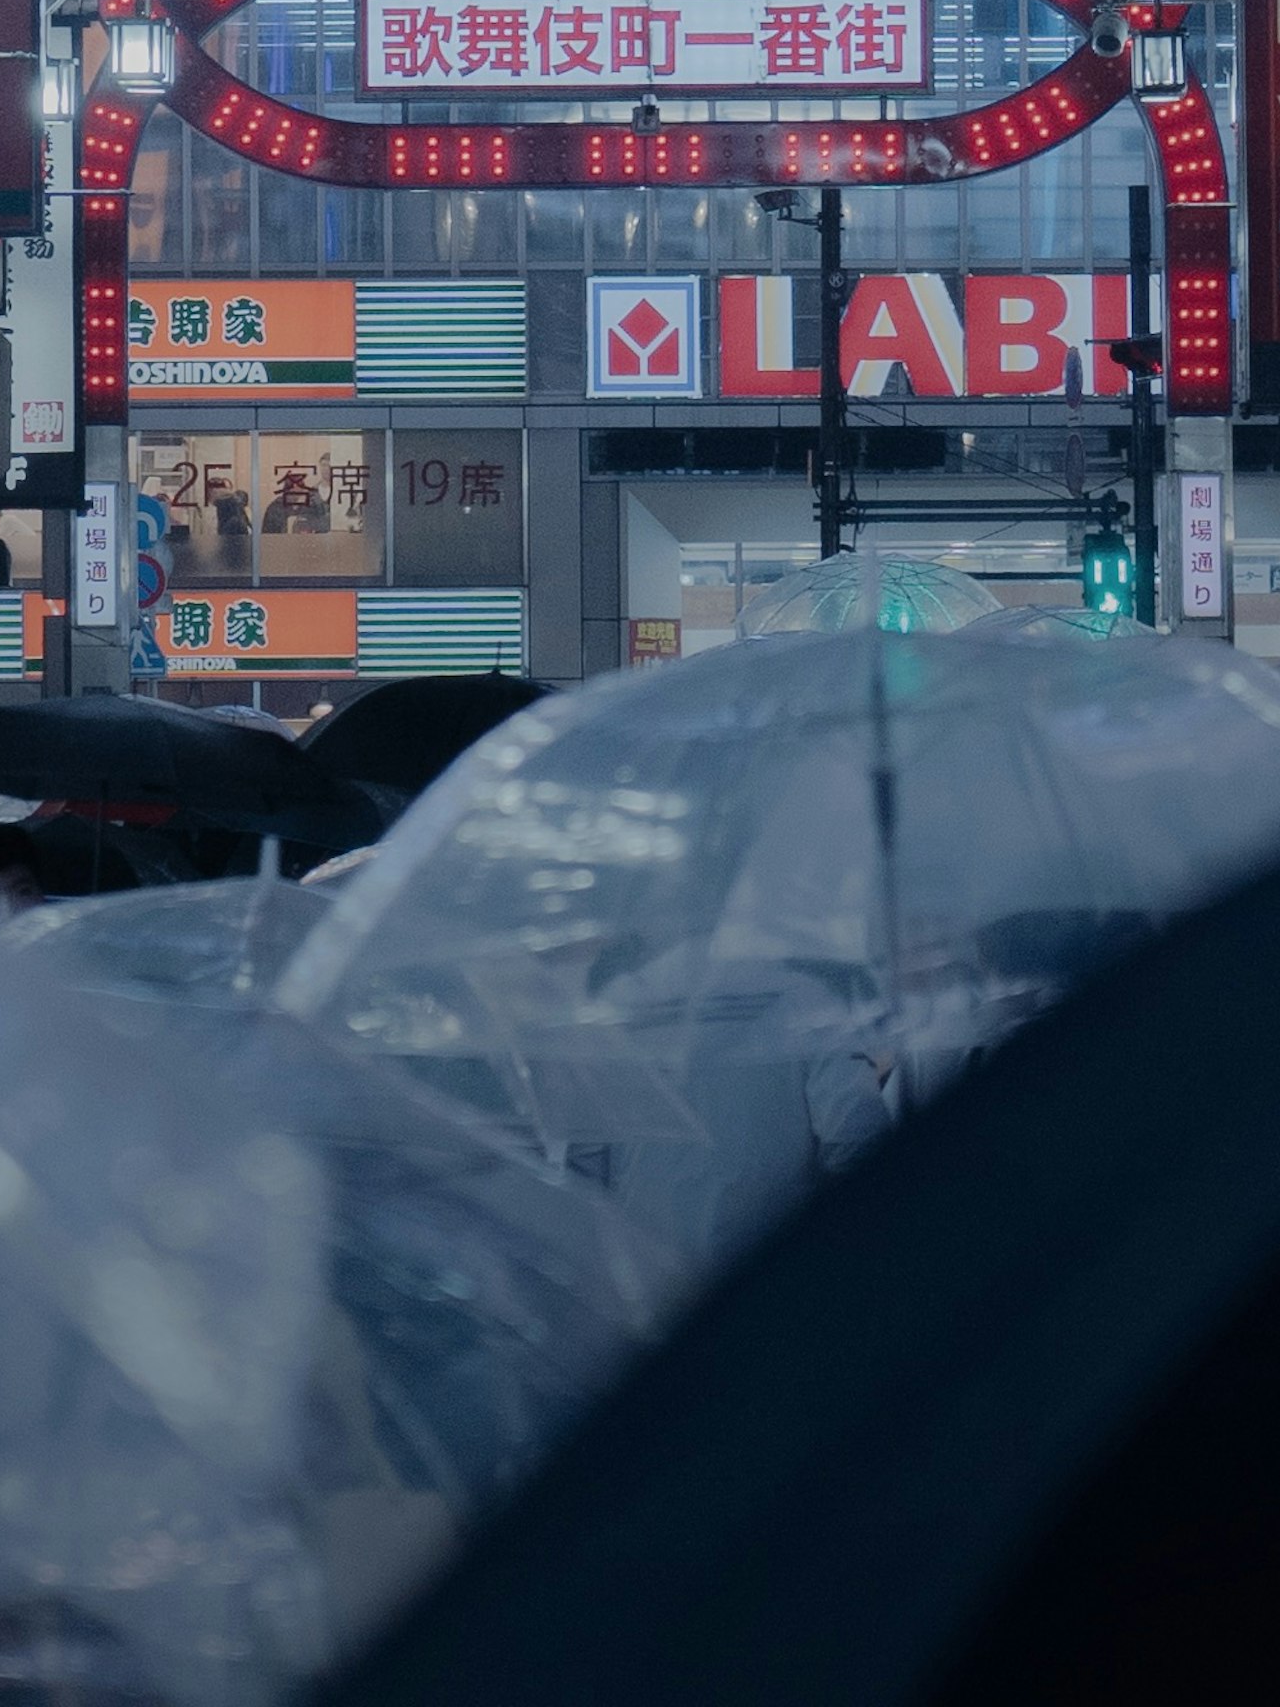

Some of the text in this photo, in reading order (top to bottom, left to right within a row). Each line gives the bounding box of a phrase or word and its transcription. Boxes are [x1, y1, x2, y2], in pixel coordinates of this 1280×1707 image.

[380, 4, 908, 78] 歌舞伎町一番街
[171, 459, 505, 510] 2F 客席 19席
[83, 494, 108, 616] 劇場通り
[1188, 486, 1216, 608] 劇場通り
